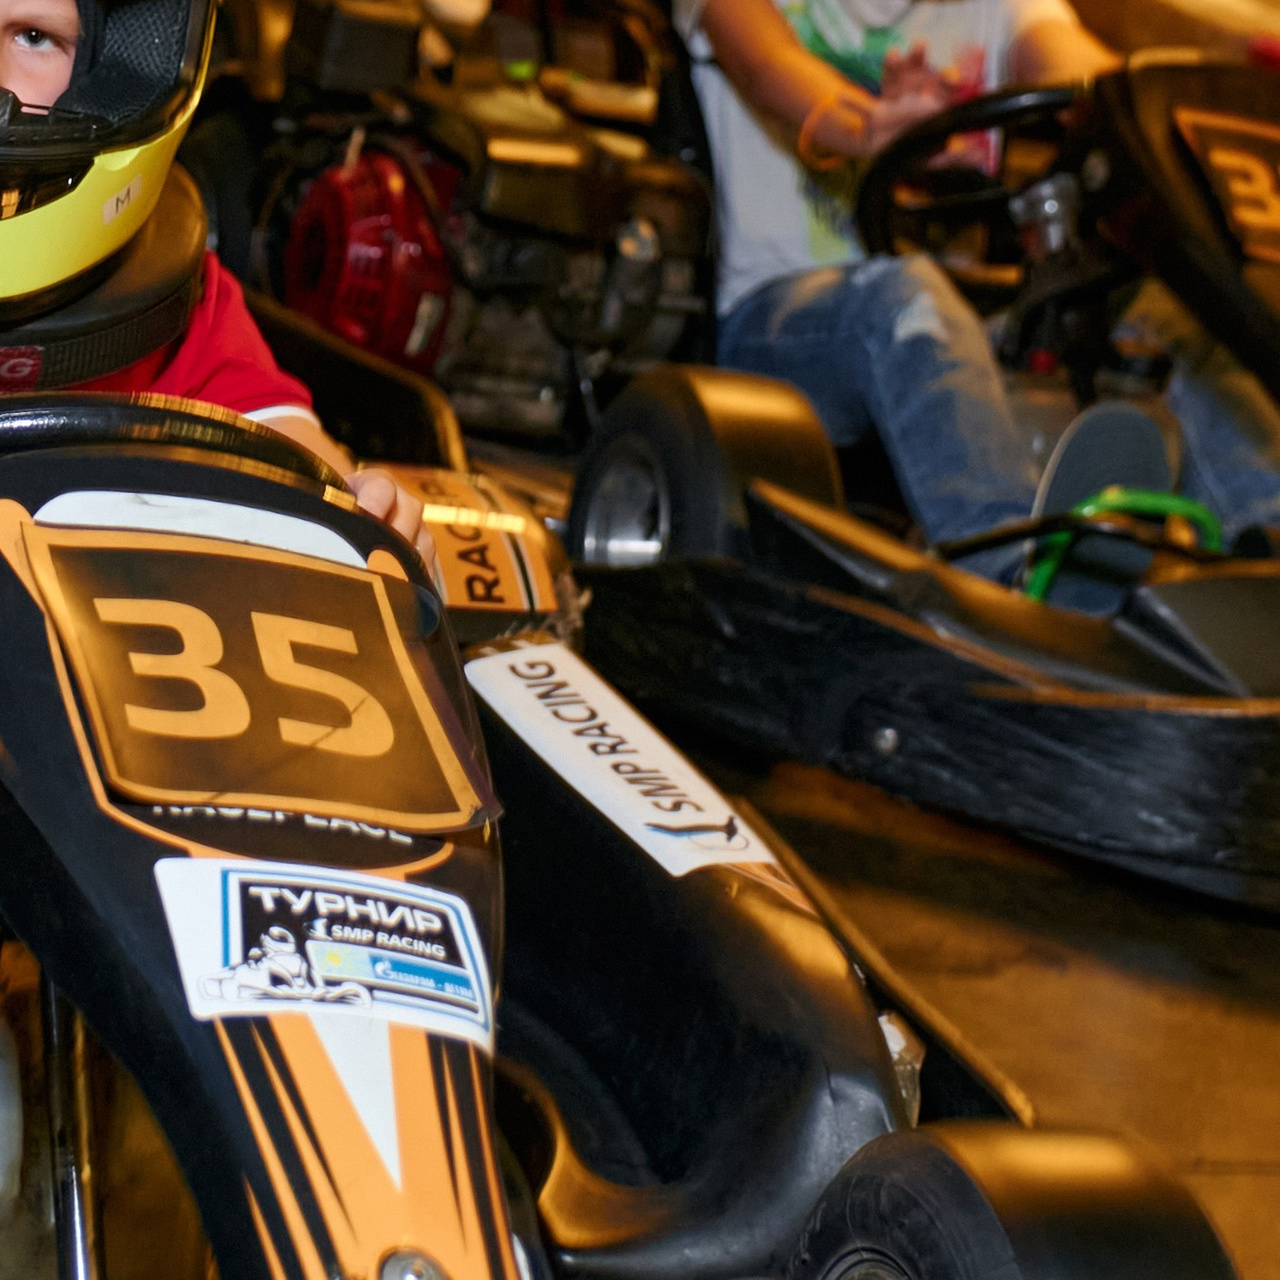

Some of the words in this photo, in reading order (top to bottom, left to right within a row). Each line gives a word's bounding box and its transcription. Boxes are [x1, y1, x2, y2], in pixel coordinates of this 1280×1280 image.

[93, 597, 395, 758] 35
[508, 659, 639, 756] RACING
[609, 760, 704, 813] SMP
[249, 884, 444, 935] ТУРНИР
[331, 923, 376, 944] SMP
[375, 931, 447, 960] RACING
